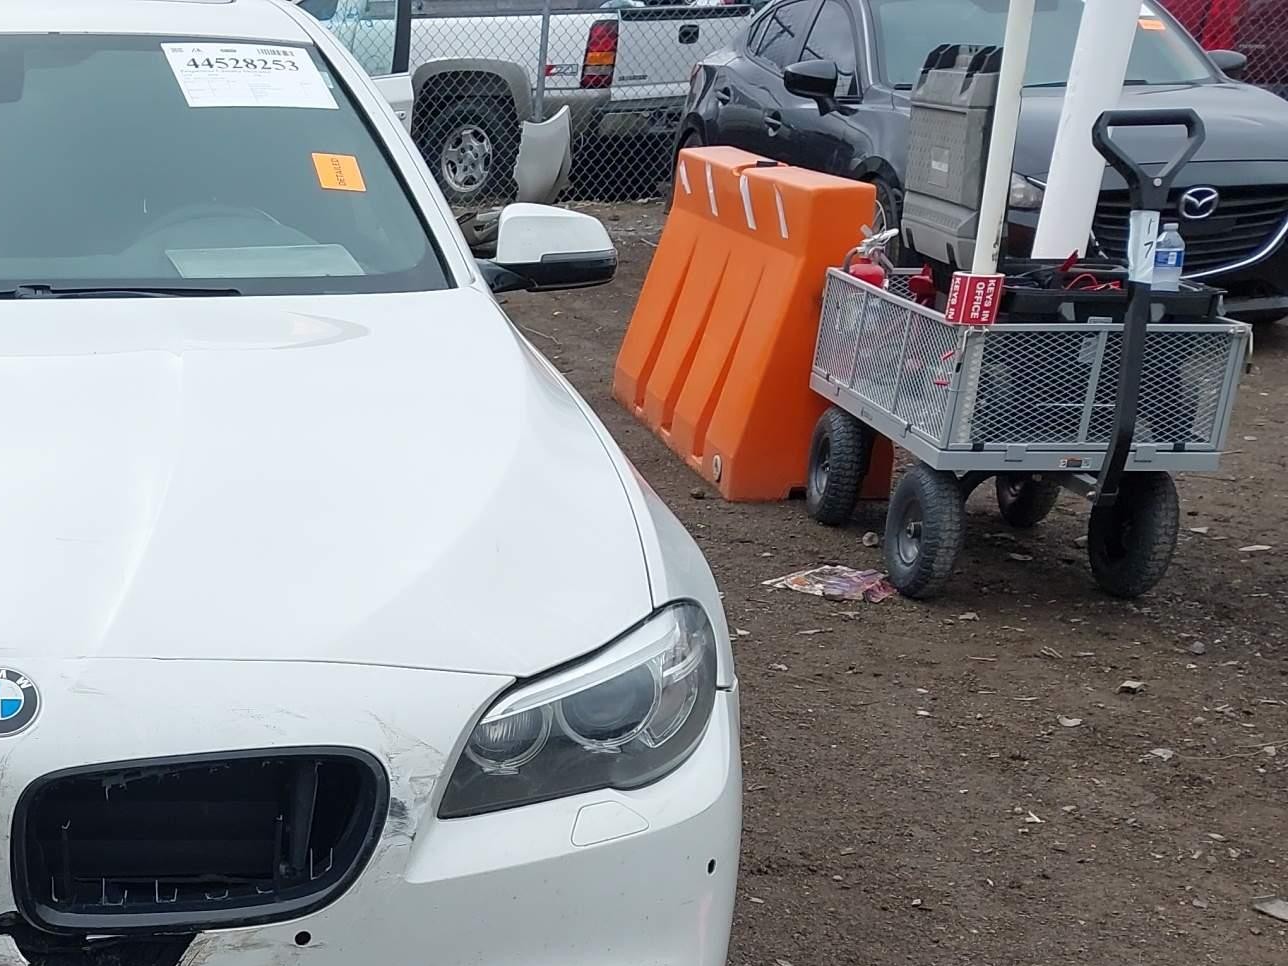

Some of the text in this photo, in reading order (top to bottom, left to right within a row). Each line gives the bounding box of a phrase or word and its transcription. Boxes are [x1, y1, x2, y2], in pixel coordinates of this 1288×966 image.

[186, 57, 300, 72] 44528253
[331, 158, 347, 187] DETAILED
[947, 277, 962, 320] KEYS IN
[970, 282, 986, 319] OFFICE
[981, 279, 997, 322] KEYS IN
